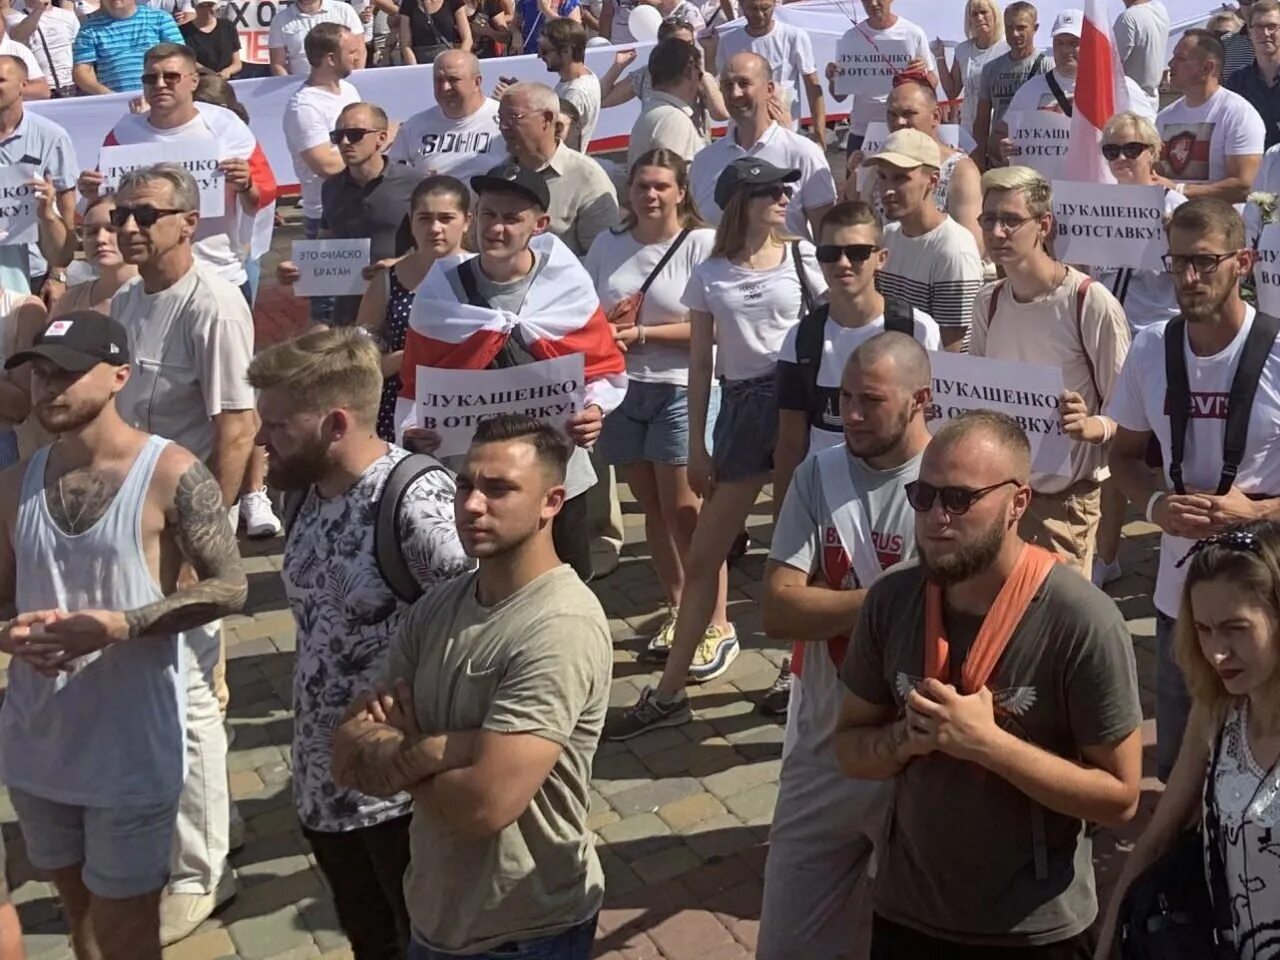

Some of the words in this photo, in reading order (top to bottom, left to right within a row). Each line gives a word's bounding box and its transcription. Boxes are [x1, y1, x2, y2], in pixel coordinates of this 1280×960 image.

[848, 68, 905, 77] ОТСТАВ
[1014, 129, 1069, 139] ЛУКАШ
[1026, 145, 1069, 156] ОТСТ
[104, 159, 219, 179] ЛУНКО
[1057, 203, 1161, 220] ЛУКАШЕНКО
[1059, 223, 1068, 236] В
[1071, 224, 1161, 241] ОТСТАВКУ!
[299, 250, 319, 260] ЭТО
[320, 249, 362, 259] ФИАСКО
[313, 267, 351, 277] БРАТАН
[1261, 271, 1270, 284] В
[423, 380, 577, 407] ЛУКАШЕНКО
[931, 378, 1060, 409] ЛУКАШЕНКО
[424, 416, 437, 429] В
[948, 407, 1061, 436] ОВКУ!
[826, 527, 902, 552] BRUS
